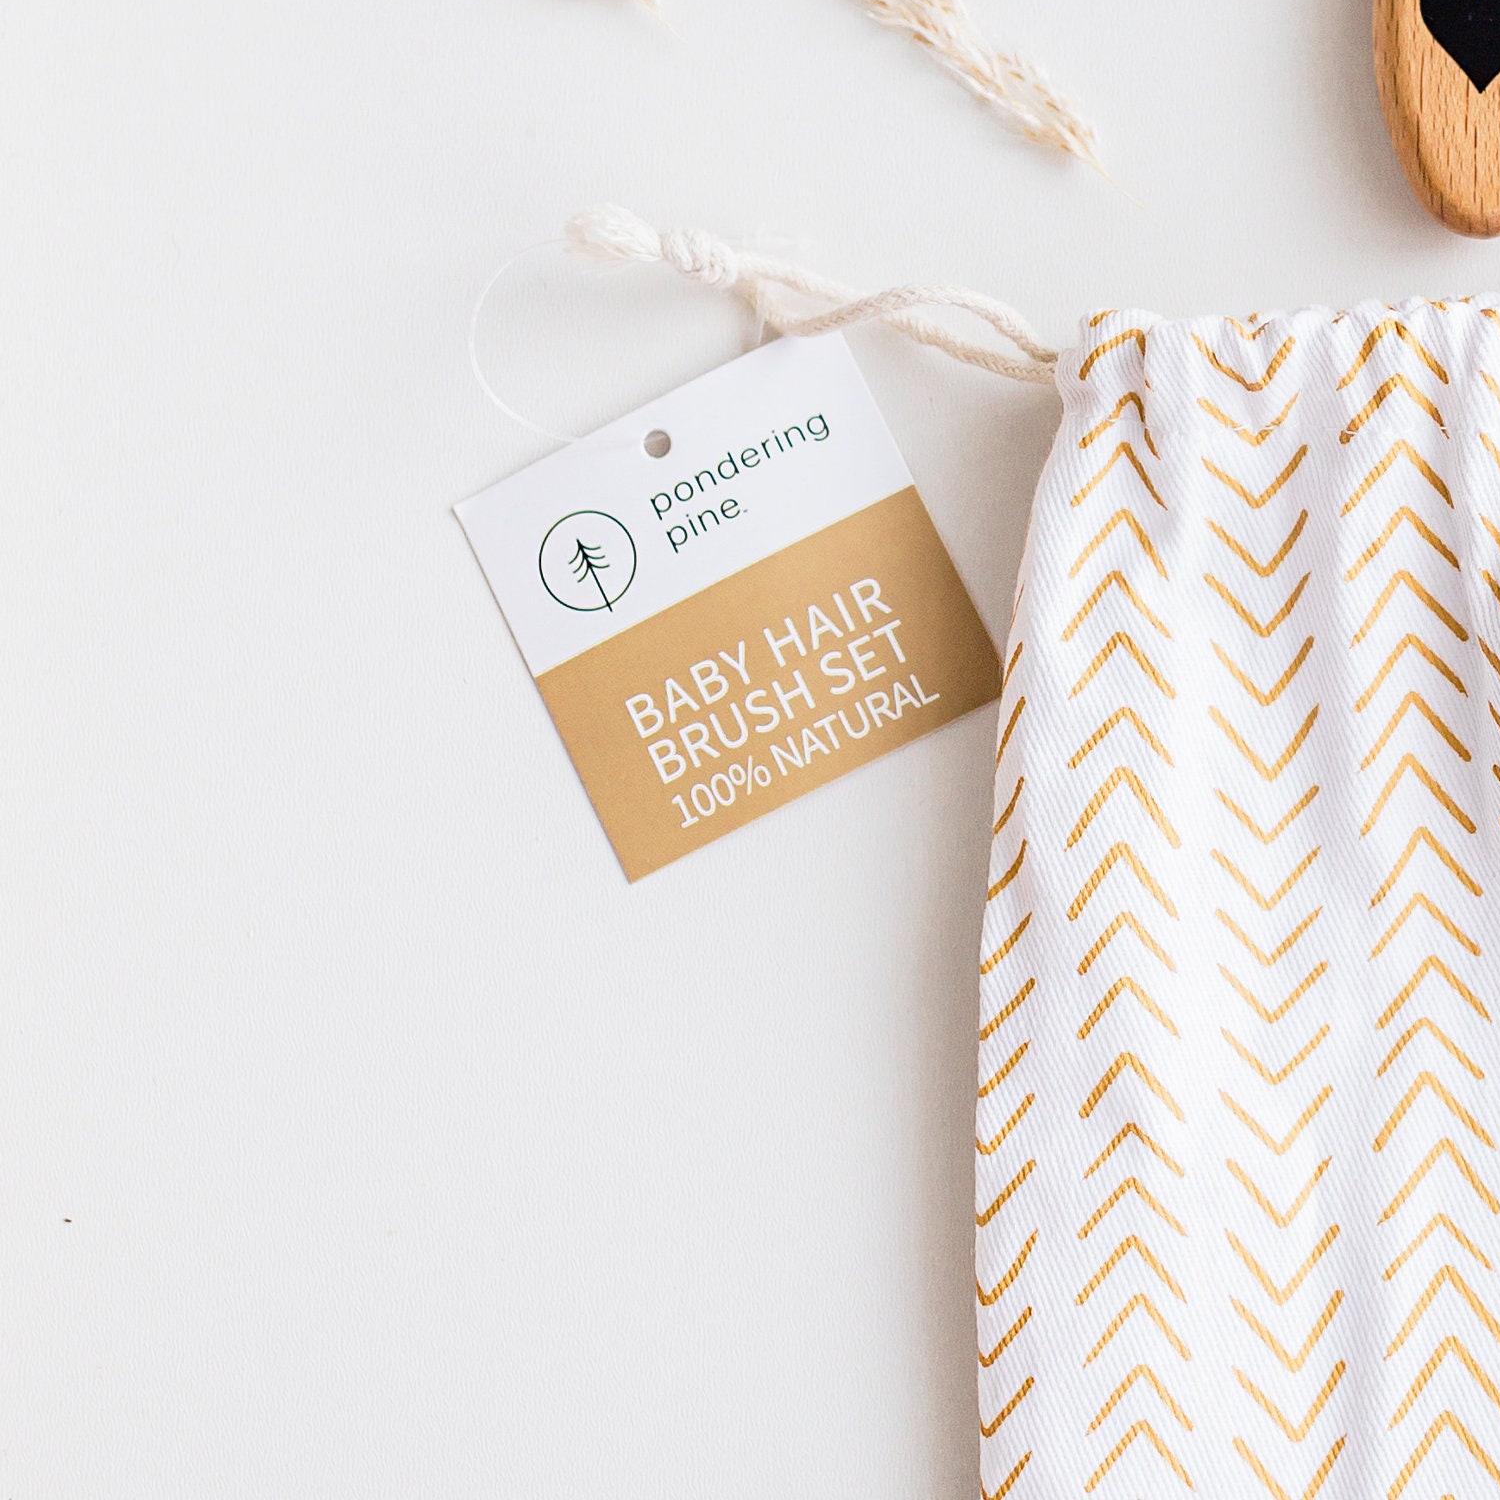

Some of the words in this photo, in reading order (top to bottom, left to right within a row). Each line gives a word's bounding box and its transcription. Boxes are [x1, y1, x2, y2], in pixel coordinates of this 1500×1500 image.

[650, 412, 830, 520] pondering
[625, 641, 751, 740] BABY
[763, 577, 893, 667] HAIR
[647, 670, 817, 785] BRUSH
[819, 620, 907, 695] SET
[671, 755, 772, 828] 100%
[770, 673, 940, 776] NATURAL
